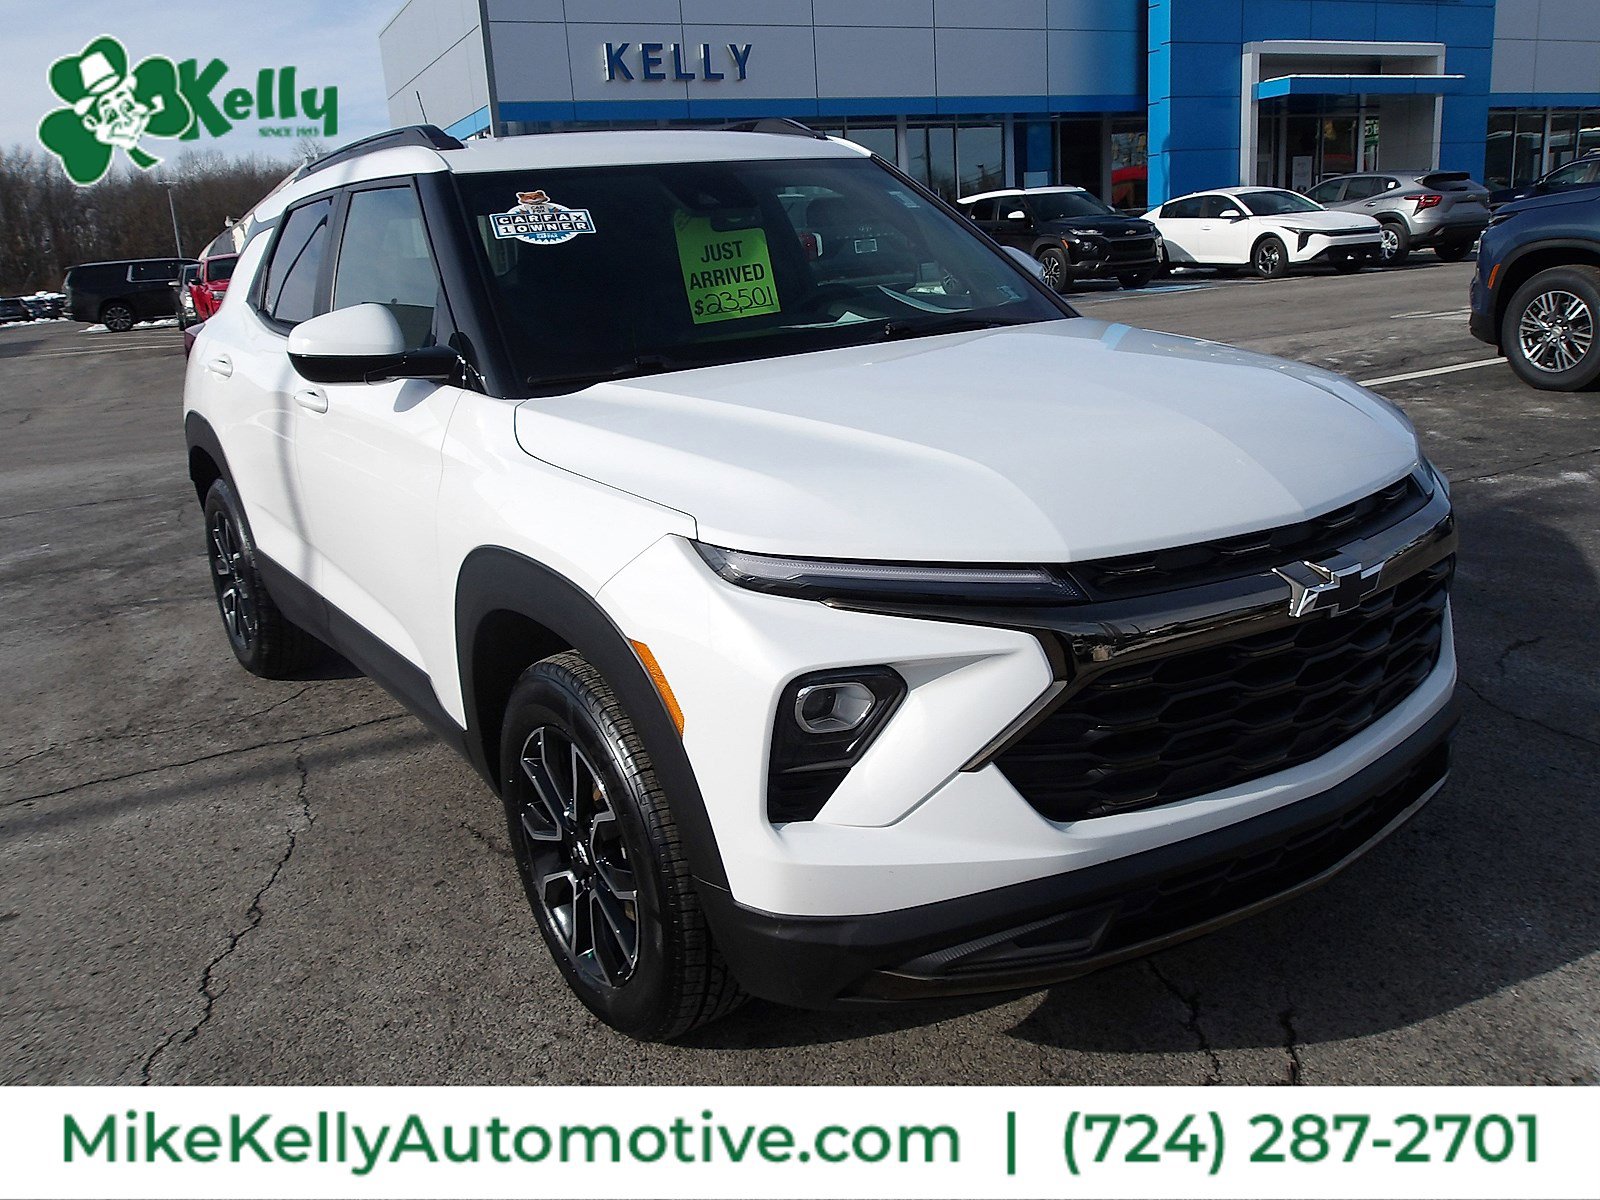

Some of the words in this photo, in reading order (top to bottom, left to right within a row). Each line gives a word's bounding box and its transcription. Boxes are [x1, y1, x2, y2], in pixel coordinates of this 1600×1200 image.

[603, 42, 752, 81] KELLY
[499, 212, 584, 225] CARFAX
[501, 226, 512, 234] 1
[517, 223, 587, 233] OWNER
[701, 241, 742, 263] JUST
[690, 263, 765, 290] ARRIVED
